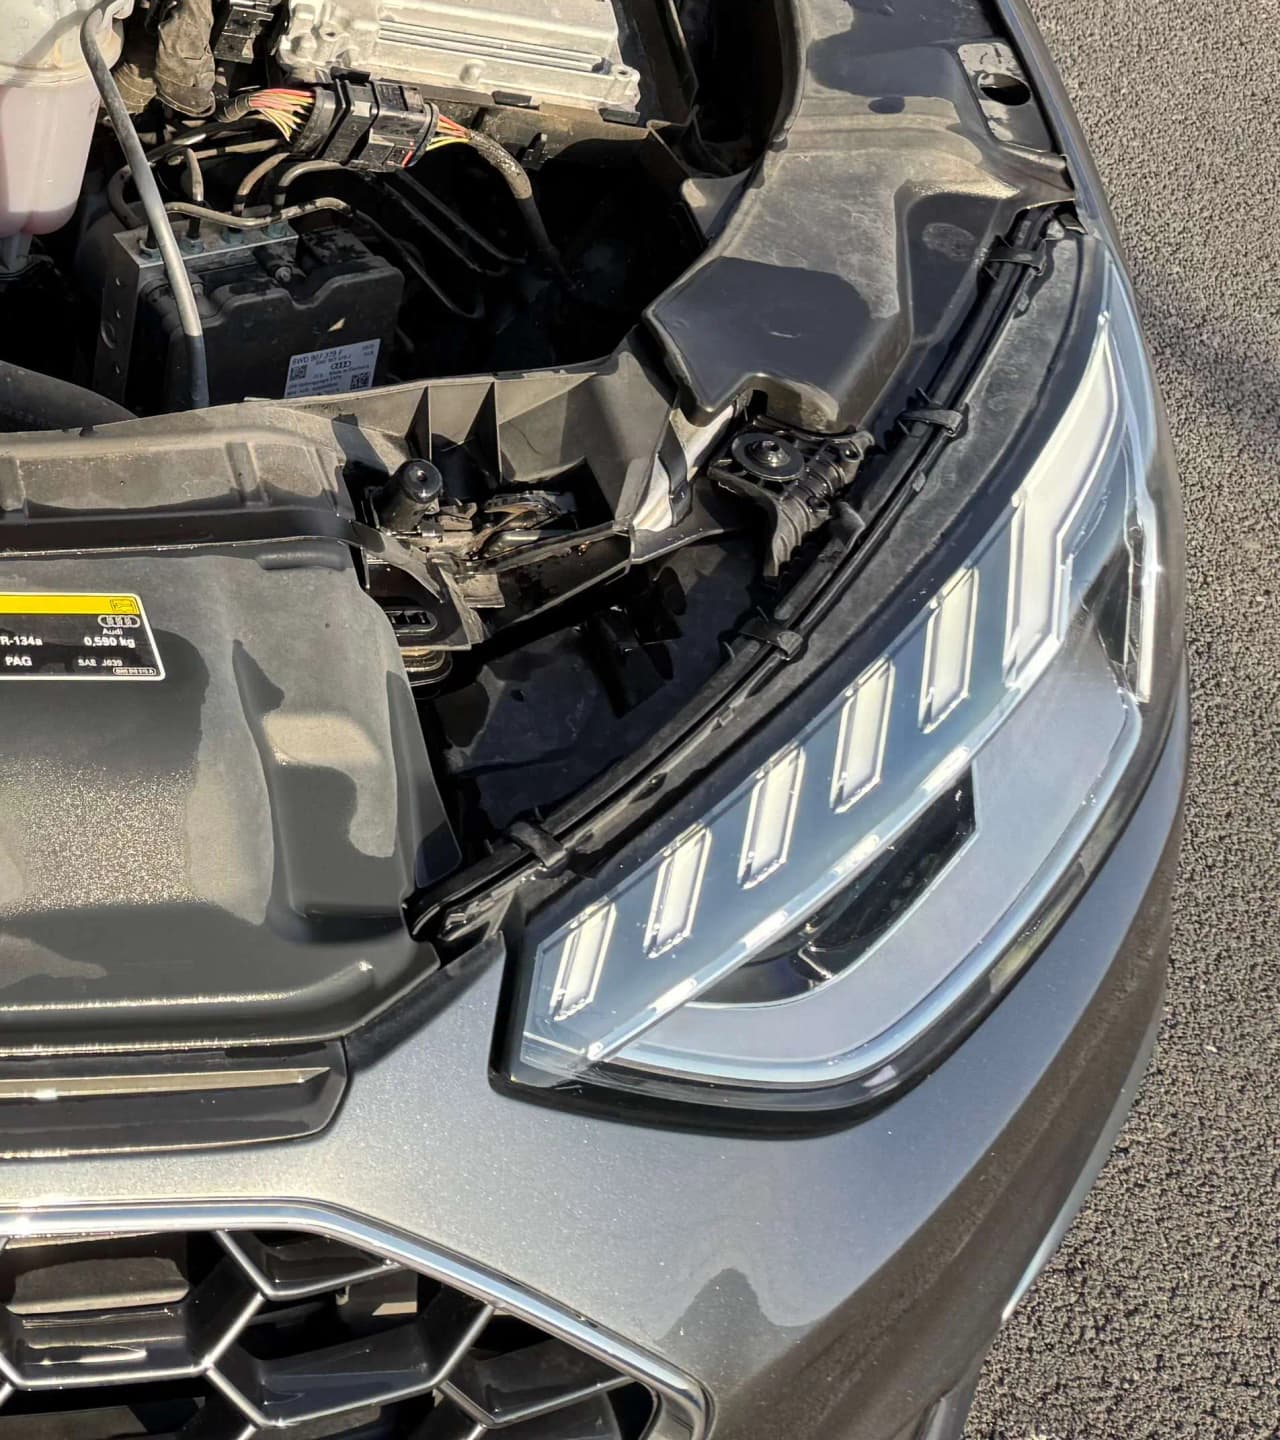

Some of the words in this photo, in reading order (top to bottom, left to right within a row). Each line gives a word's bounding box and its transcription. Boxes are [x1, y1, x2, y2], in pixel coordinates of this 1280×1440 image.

[102, 628, 123, 636] Audi
[0, 636, 44, 647] R-134a
[119, 636, 136, 649] kg
[4, 656, 33, 667] PAG
